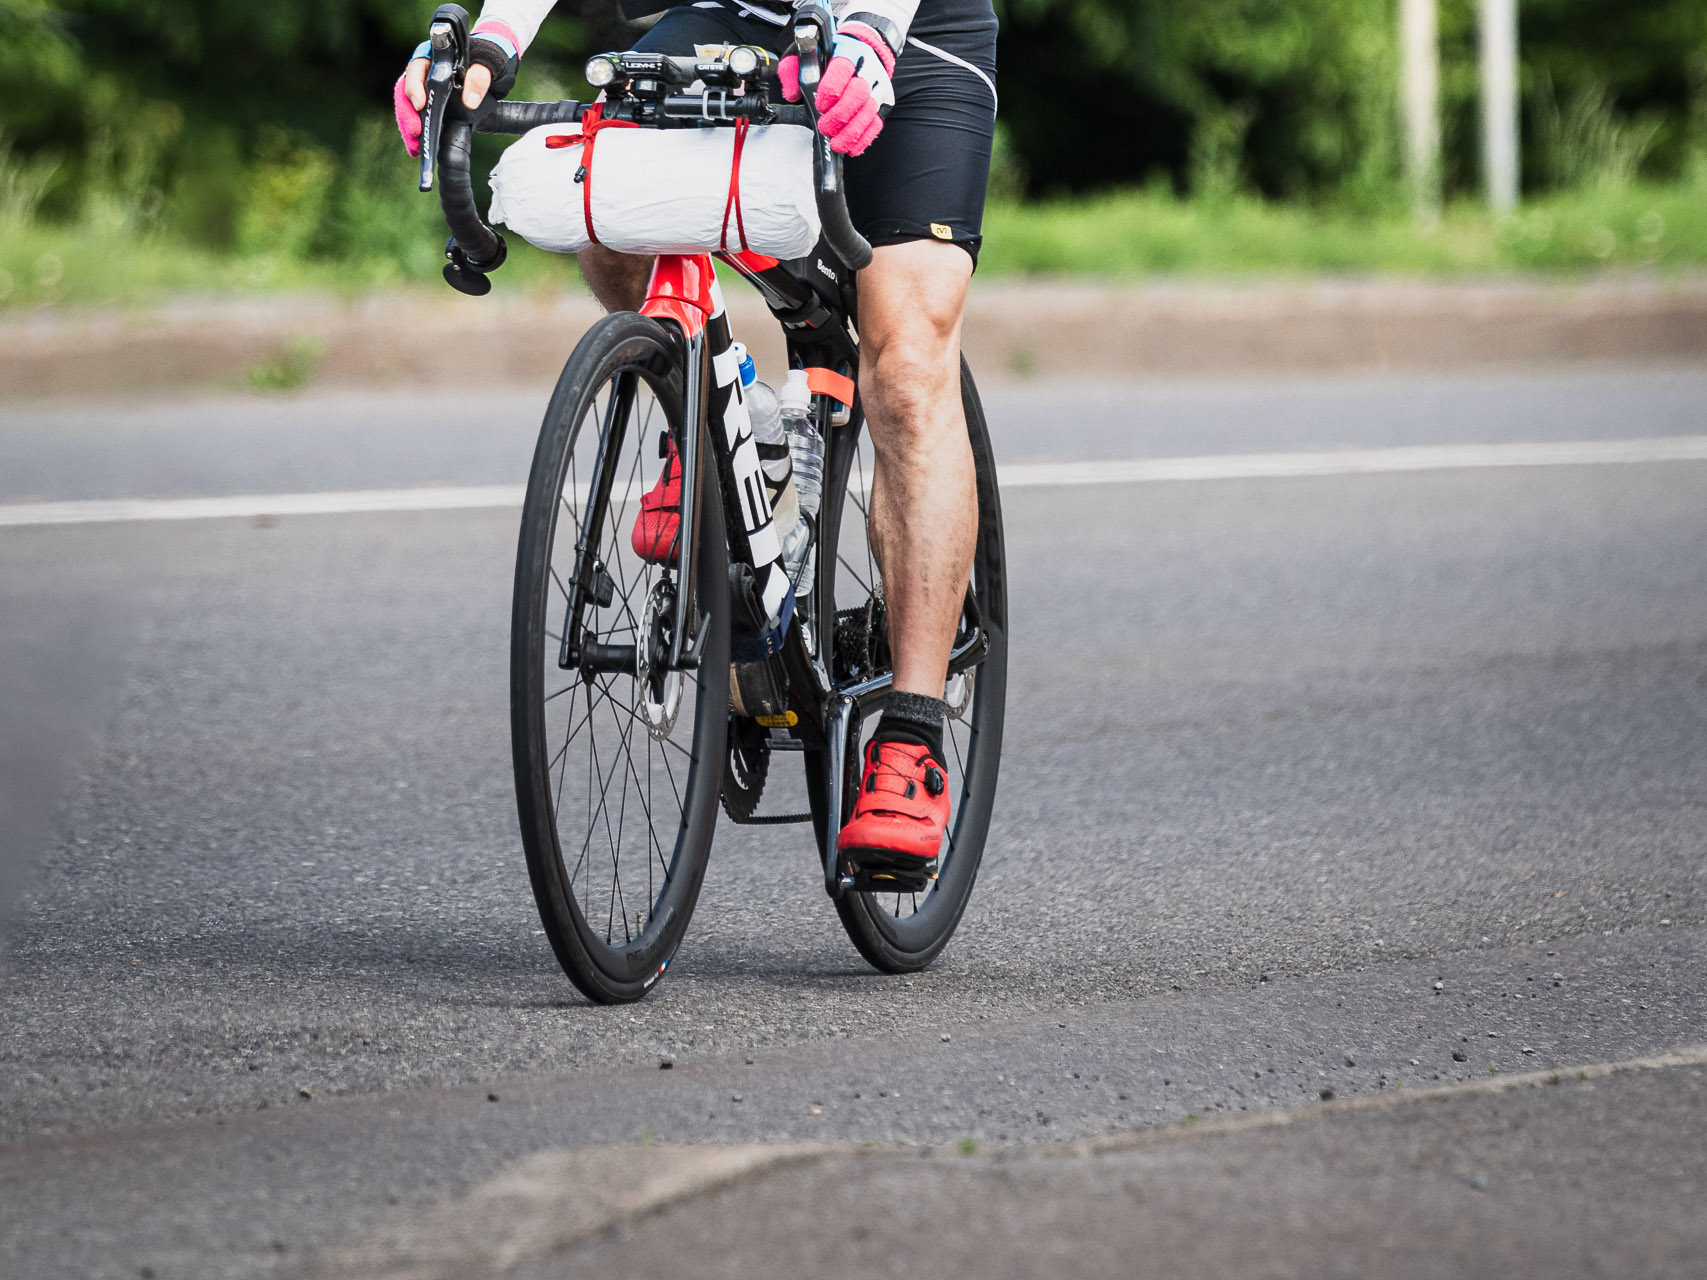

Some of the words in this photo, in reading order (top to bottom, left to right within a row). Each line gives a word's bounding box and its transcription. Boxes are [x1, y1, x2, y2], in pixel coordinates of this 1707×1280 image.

[625, 61, 656, 69] LEZYNE
[423, 88, 435, 160] ULTEGRA
[816, 258, 836, 280] Bento
